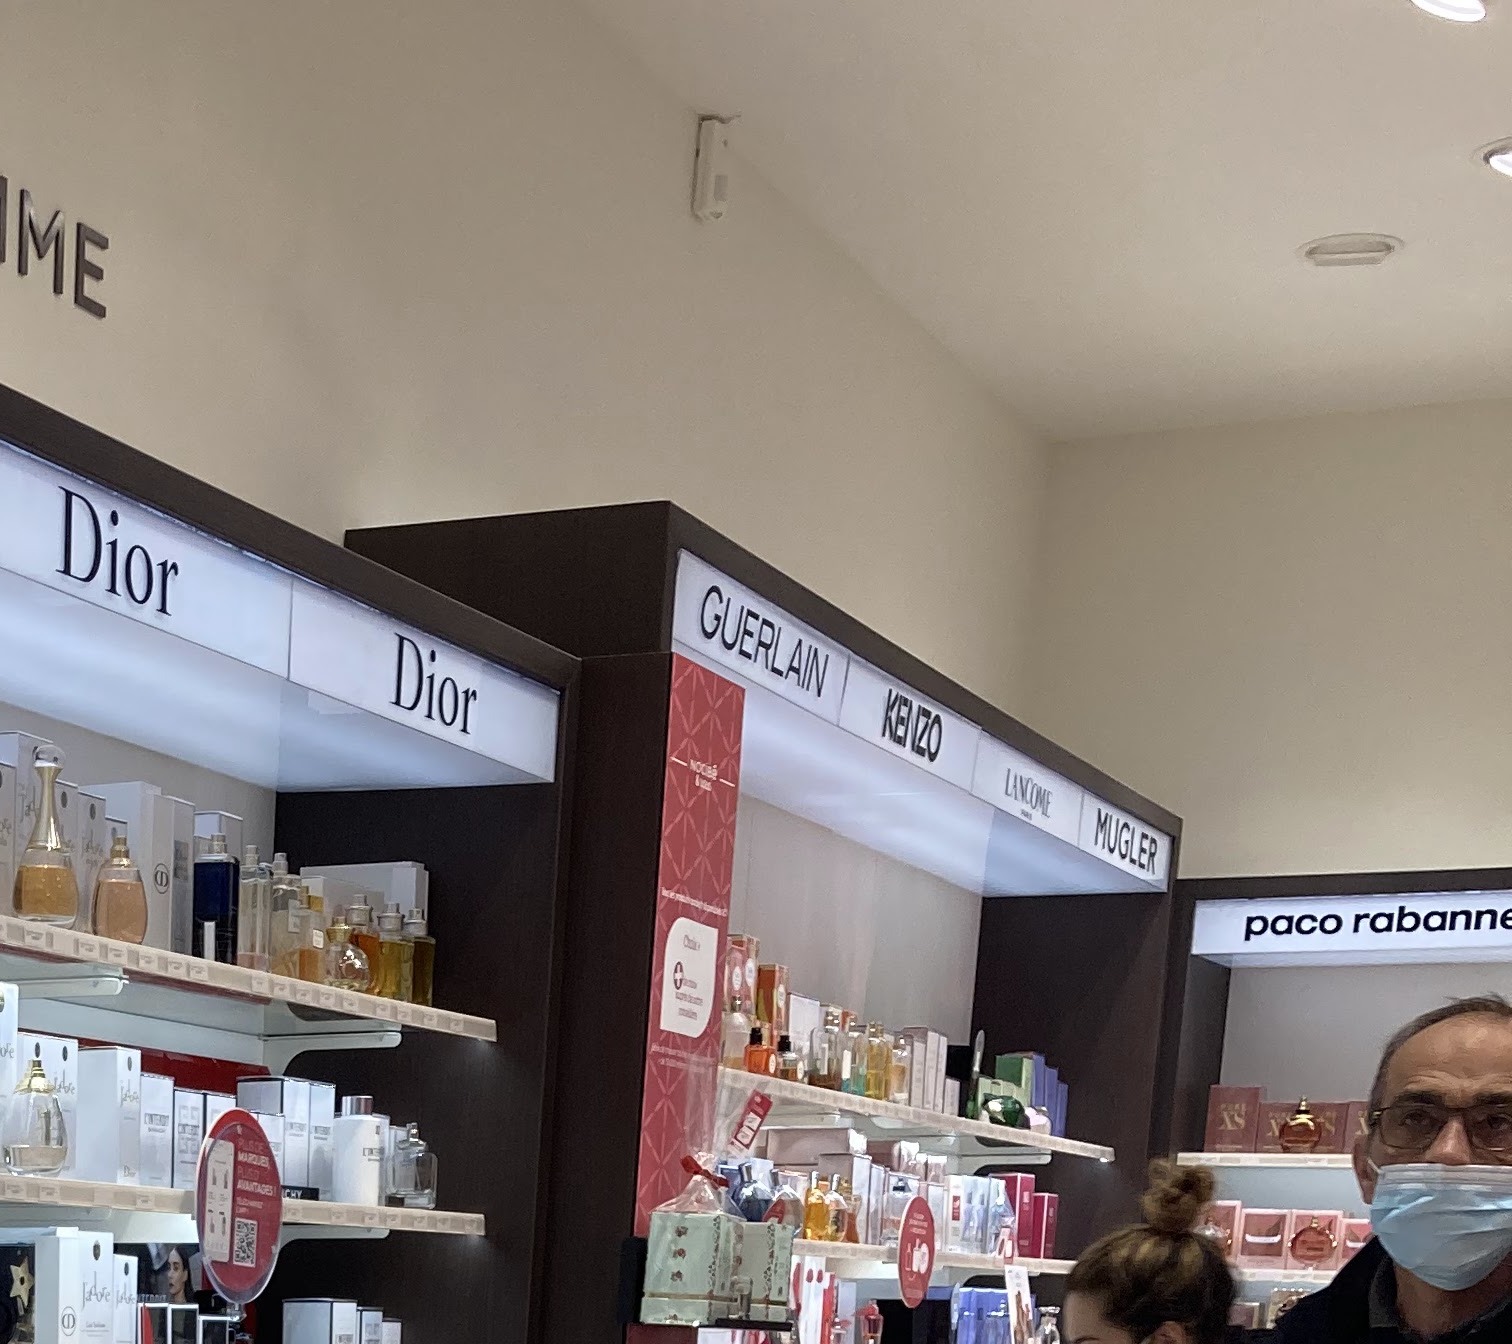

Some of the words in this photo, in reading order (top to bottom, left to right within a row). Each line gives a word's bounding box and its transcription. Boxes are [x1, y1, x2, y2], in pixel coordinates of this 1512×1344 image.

[56, 485, 179, 616] Dior
[390, 632, 478, 735] Dior
[699, 585, 829, 699] GUERLAIN
[881, 688, 943, 763] KENZO
[1093, 807, 1159, 875] MUGLER
[1244, 912, 1343, 941] paco
[1353, 905, 1512, 935] rabanne
